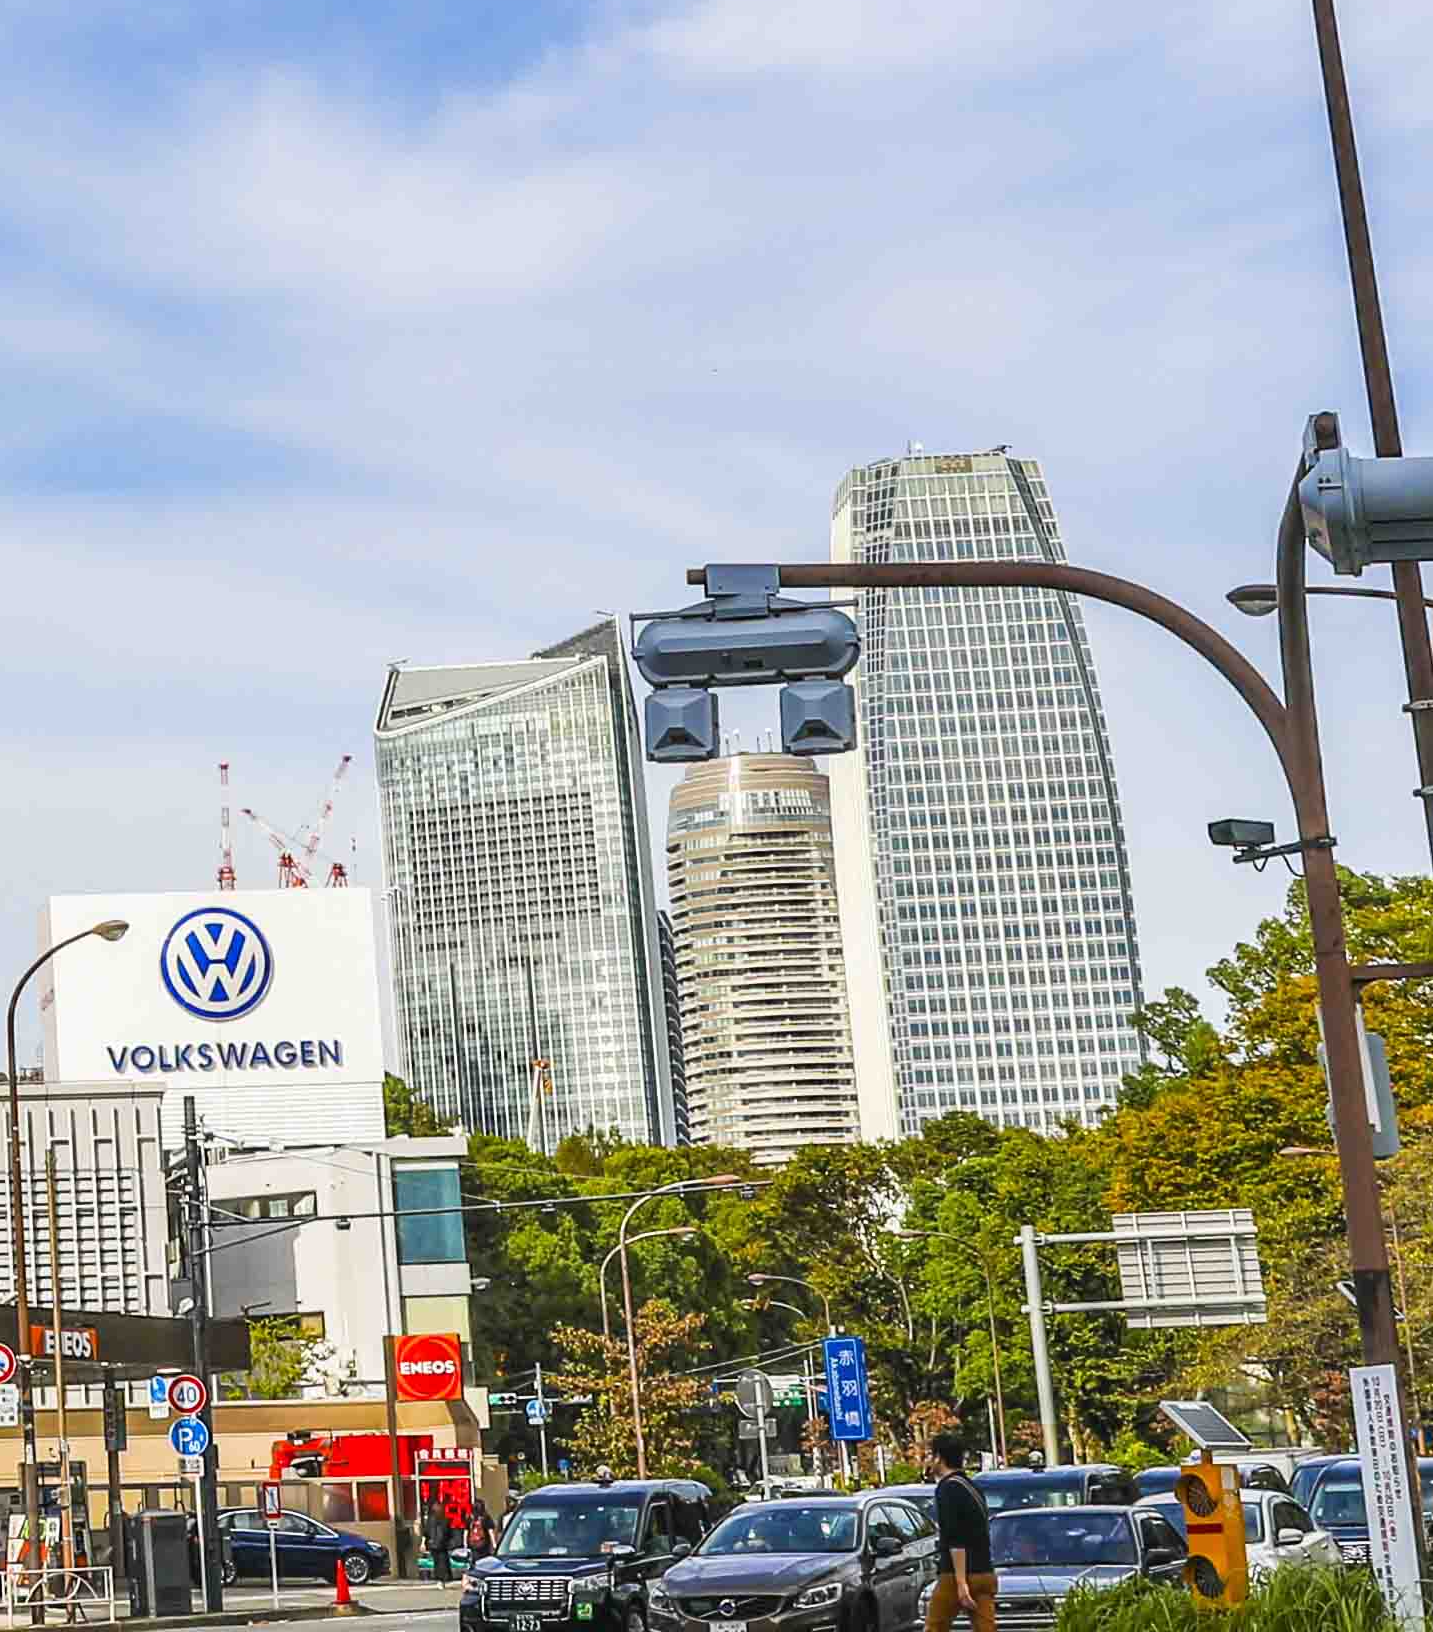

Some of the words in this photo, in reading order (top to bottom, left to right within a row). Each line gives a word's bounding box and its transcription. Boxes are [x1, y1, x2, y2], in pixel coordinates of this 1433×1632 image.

[106, 1039, 343, 1073] VOLKSWAGEN
[44, 1328, 93, 1359] EEOS
[399, 1360, 456, 1376] ENEOS
[177, 1386, 197, 1402] 40
[178, 1428, 193, 1452] P
